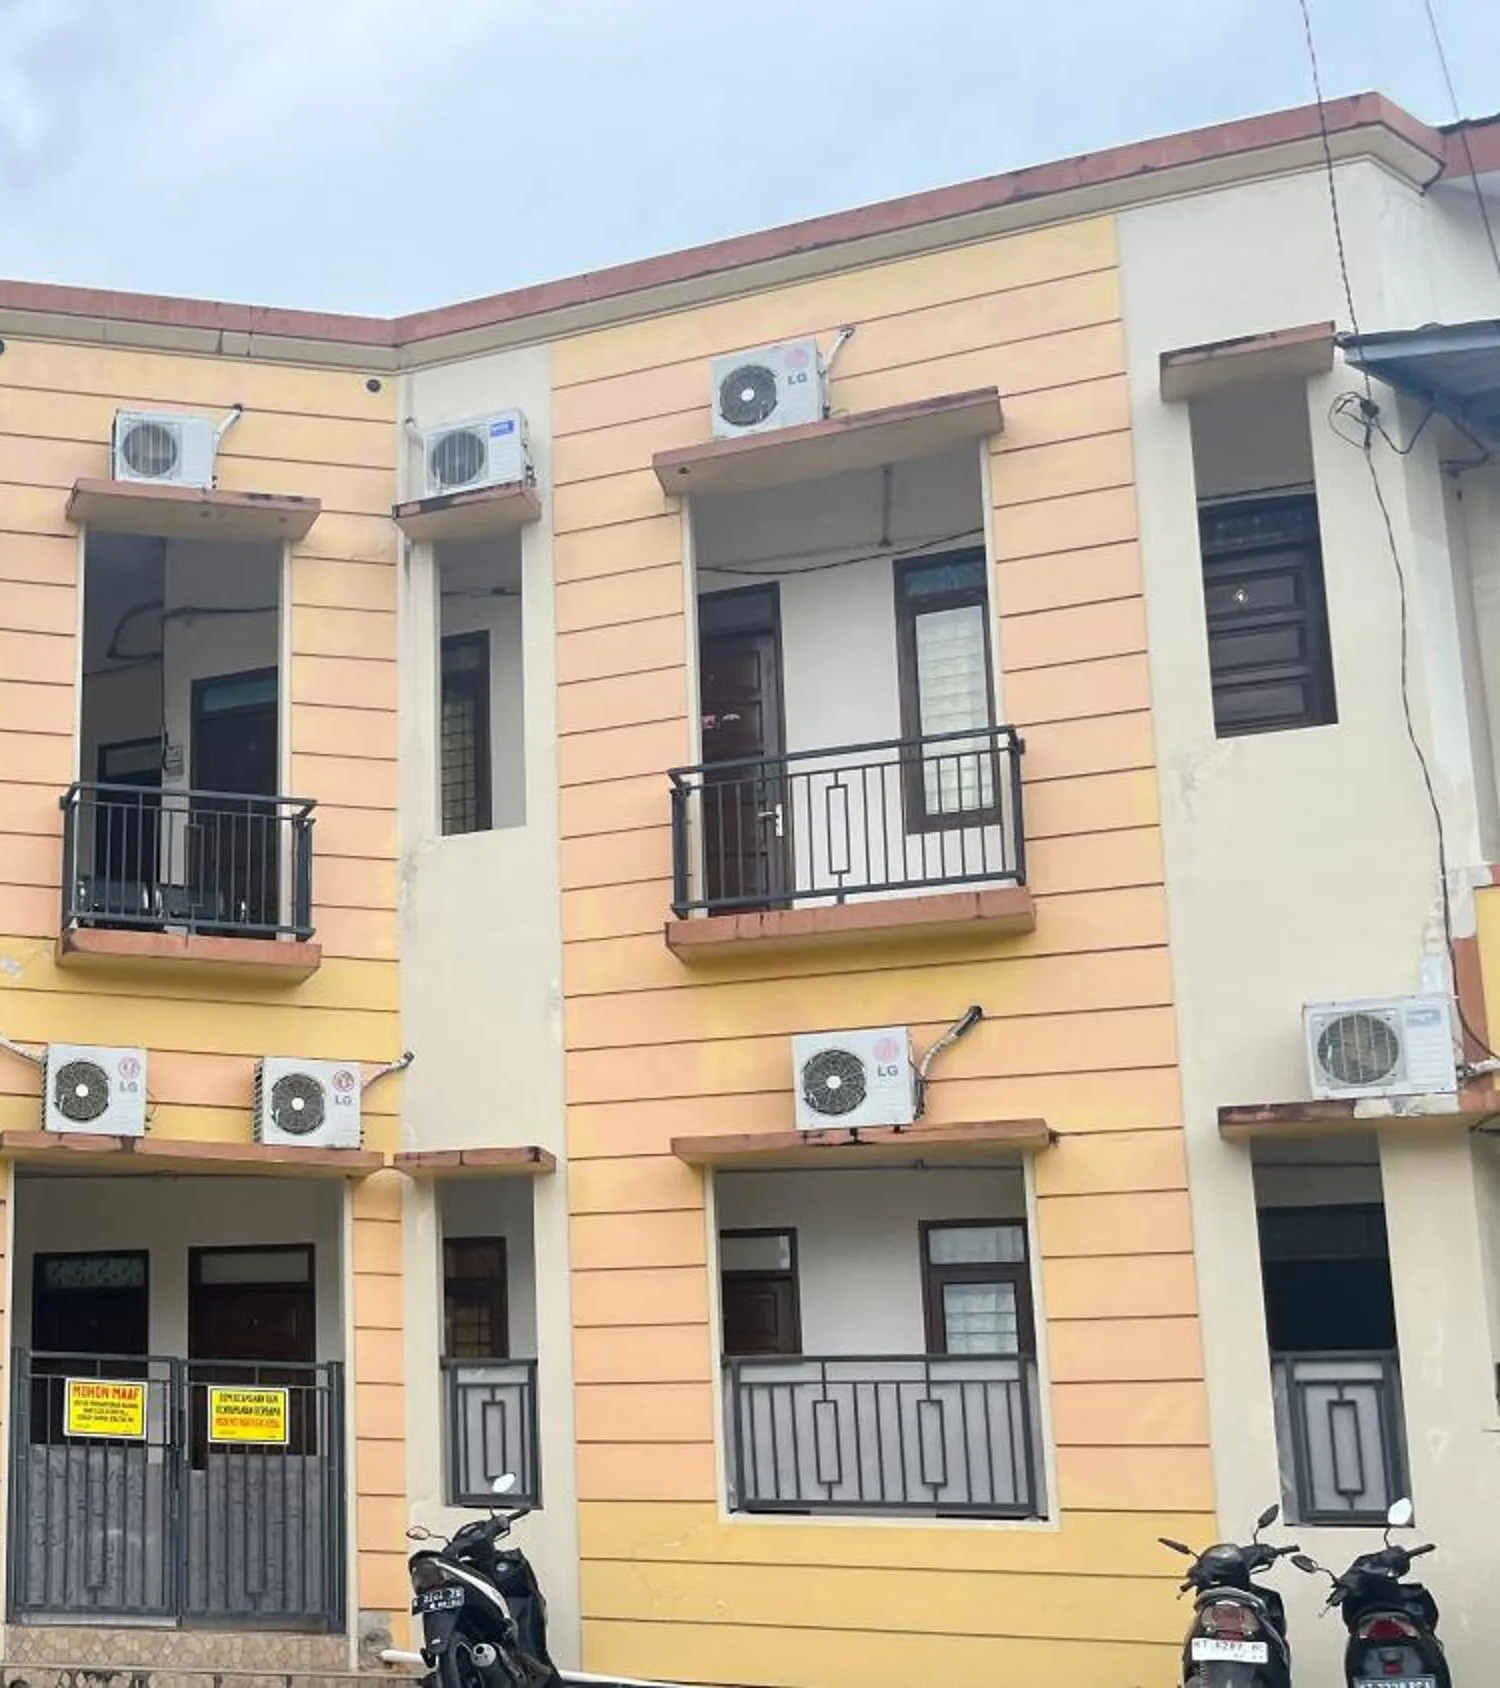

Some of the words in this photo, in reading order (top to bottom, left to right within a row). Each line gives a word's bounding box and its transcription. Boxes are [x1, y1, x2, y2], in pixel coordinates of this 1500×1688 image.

[787, 373, 807, 385] LG
[877, 1064, 898, 1077] LG
[120, 1081, 138, 1092] LG
[73, 1386, 109, 1398] MOHON
[112, 1388, 140, 1400] MAAF
